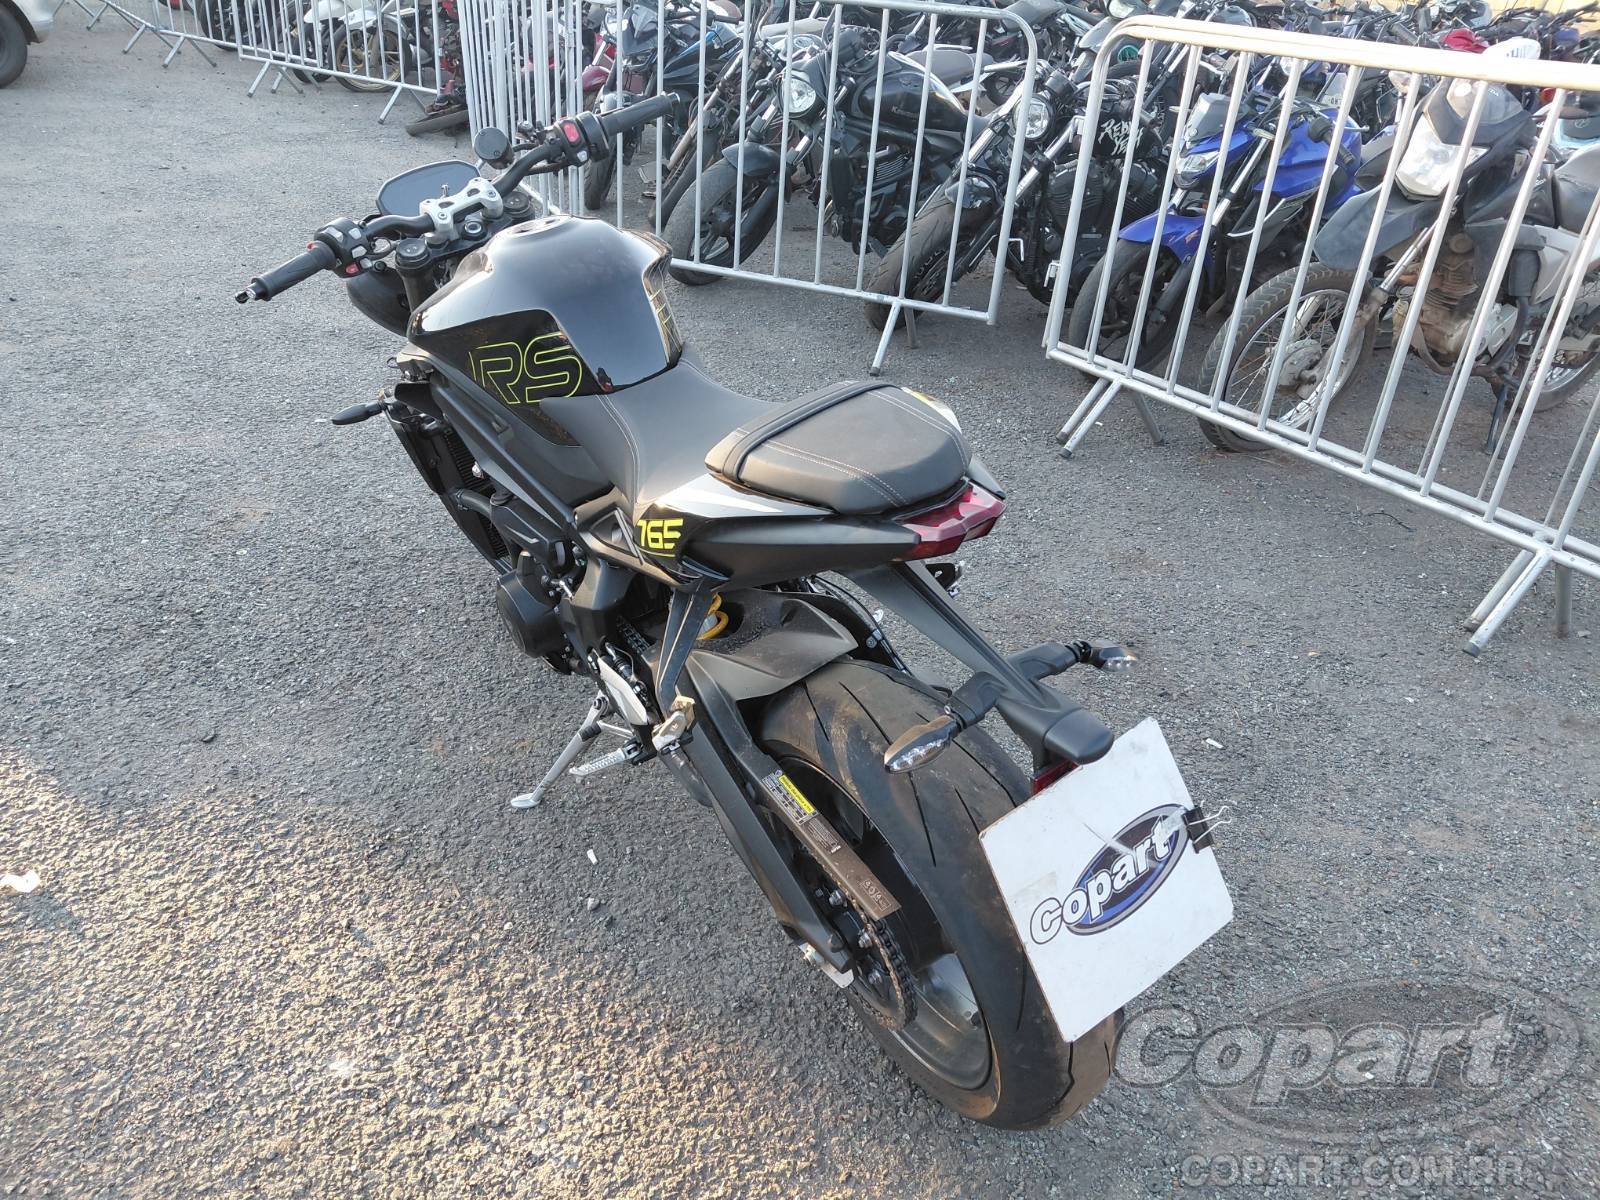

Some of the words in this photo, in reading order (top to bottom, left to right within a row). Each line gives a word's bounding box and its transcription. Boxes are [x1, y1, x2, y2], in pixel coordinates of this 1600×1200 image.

[468, 332, 583, 404] RS
[637, 518, 684, 550] 765
[1029, 816, 1174, 945] Copart
